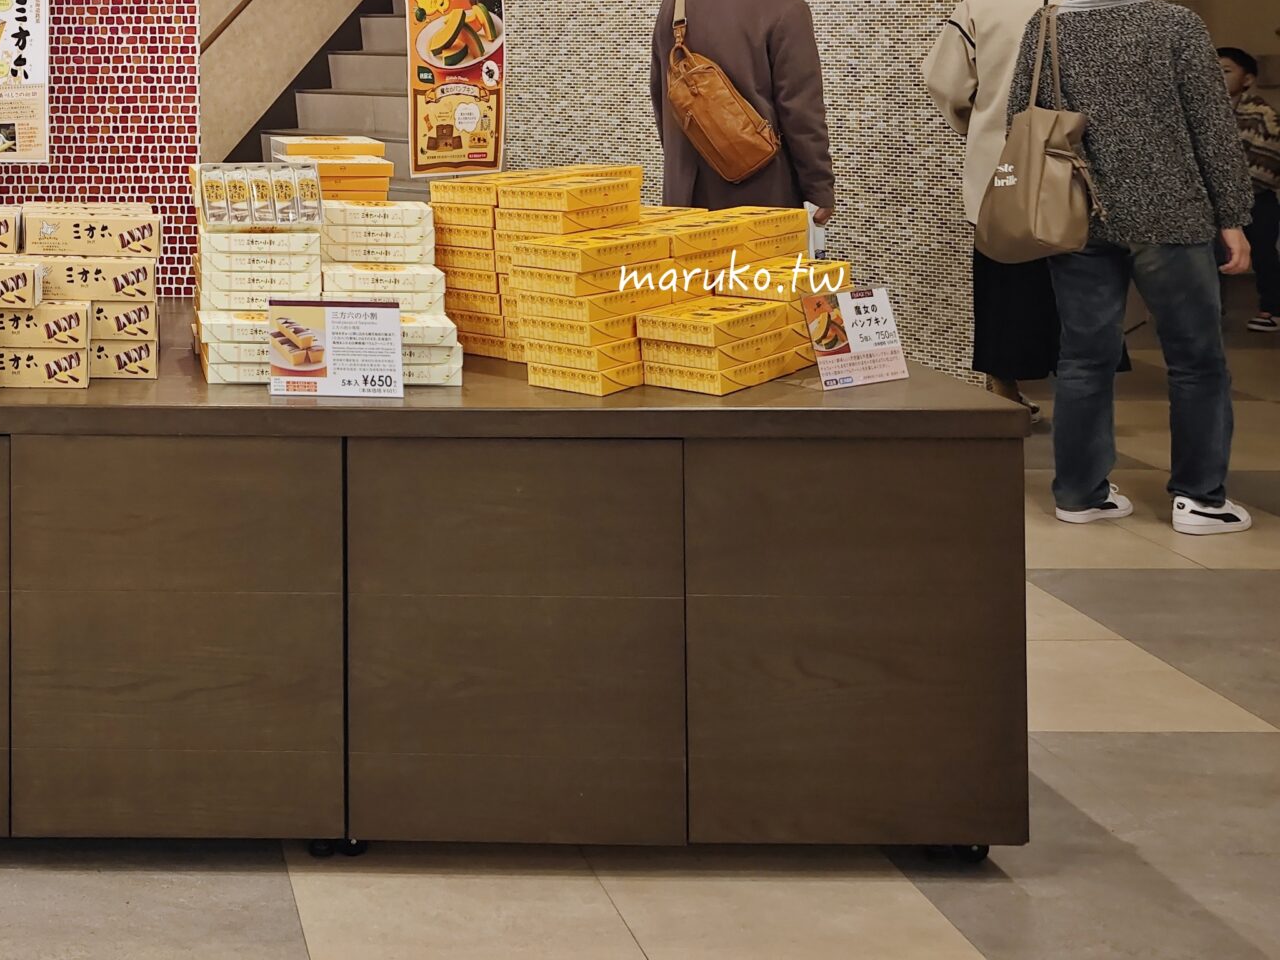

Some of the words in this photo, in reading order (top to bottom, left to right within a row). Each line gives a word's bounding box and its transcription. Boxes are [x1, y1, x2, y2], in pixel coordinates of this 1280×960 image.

[72, 223, 112, 240] 三方六
[66, 266, 106, 283] 三方六
[331, 311, 378, 321] 三方六の小割
[854, 304, 878, 315] 魔女の
[851, 316, 888, 328] パンプキン
[341, 378, 360, 387] 5本入
[362, 374, 393, 388] ¥650
